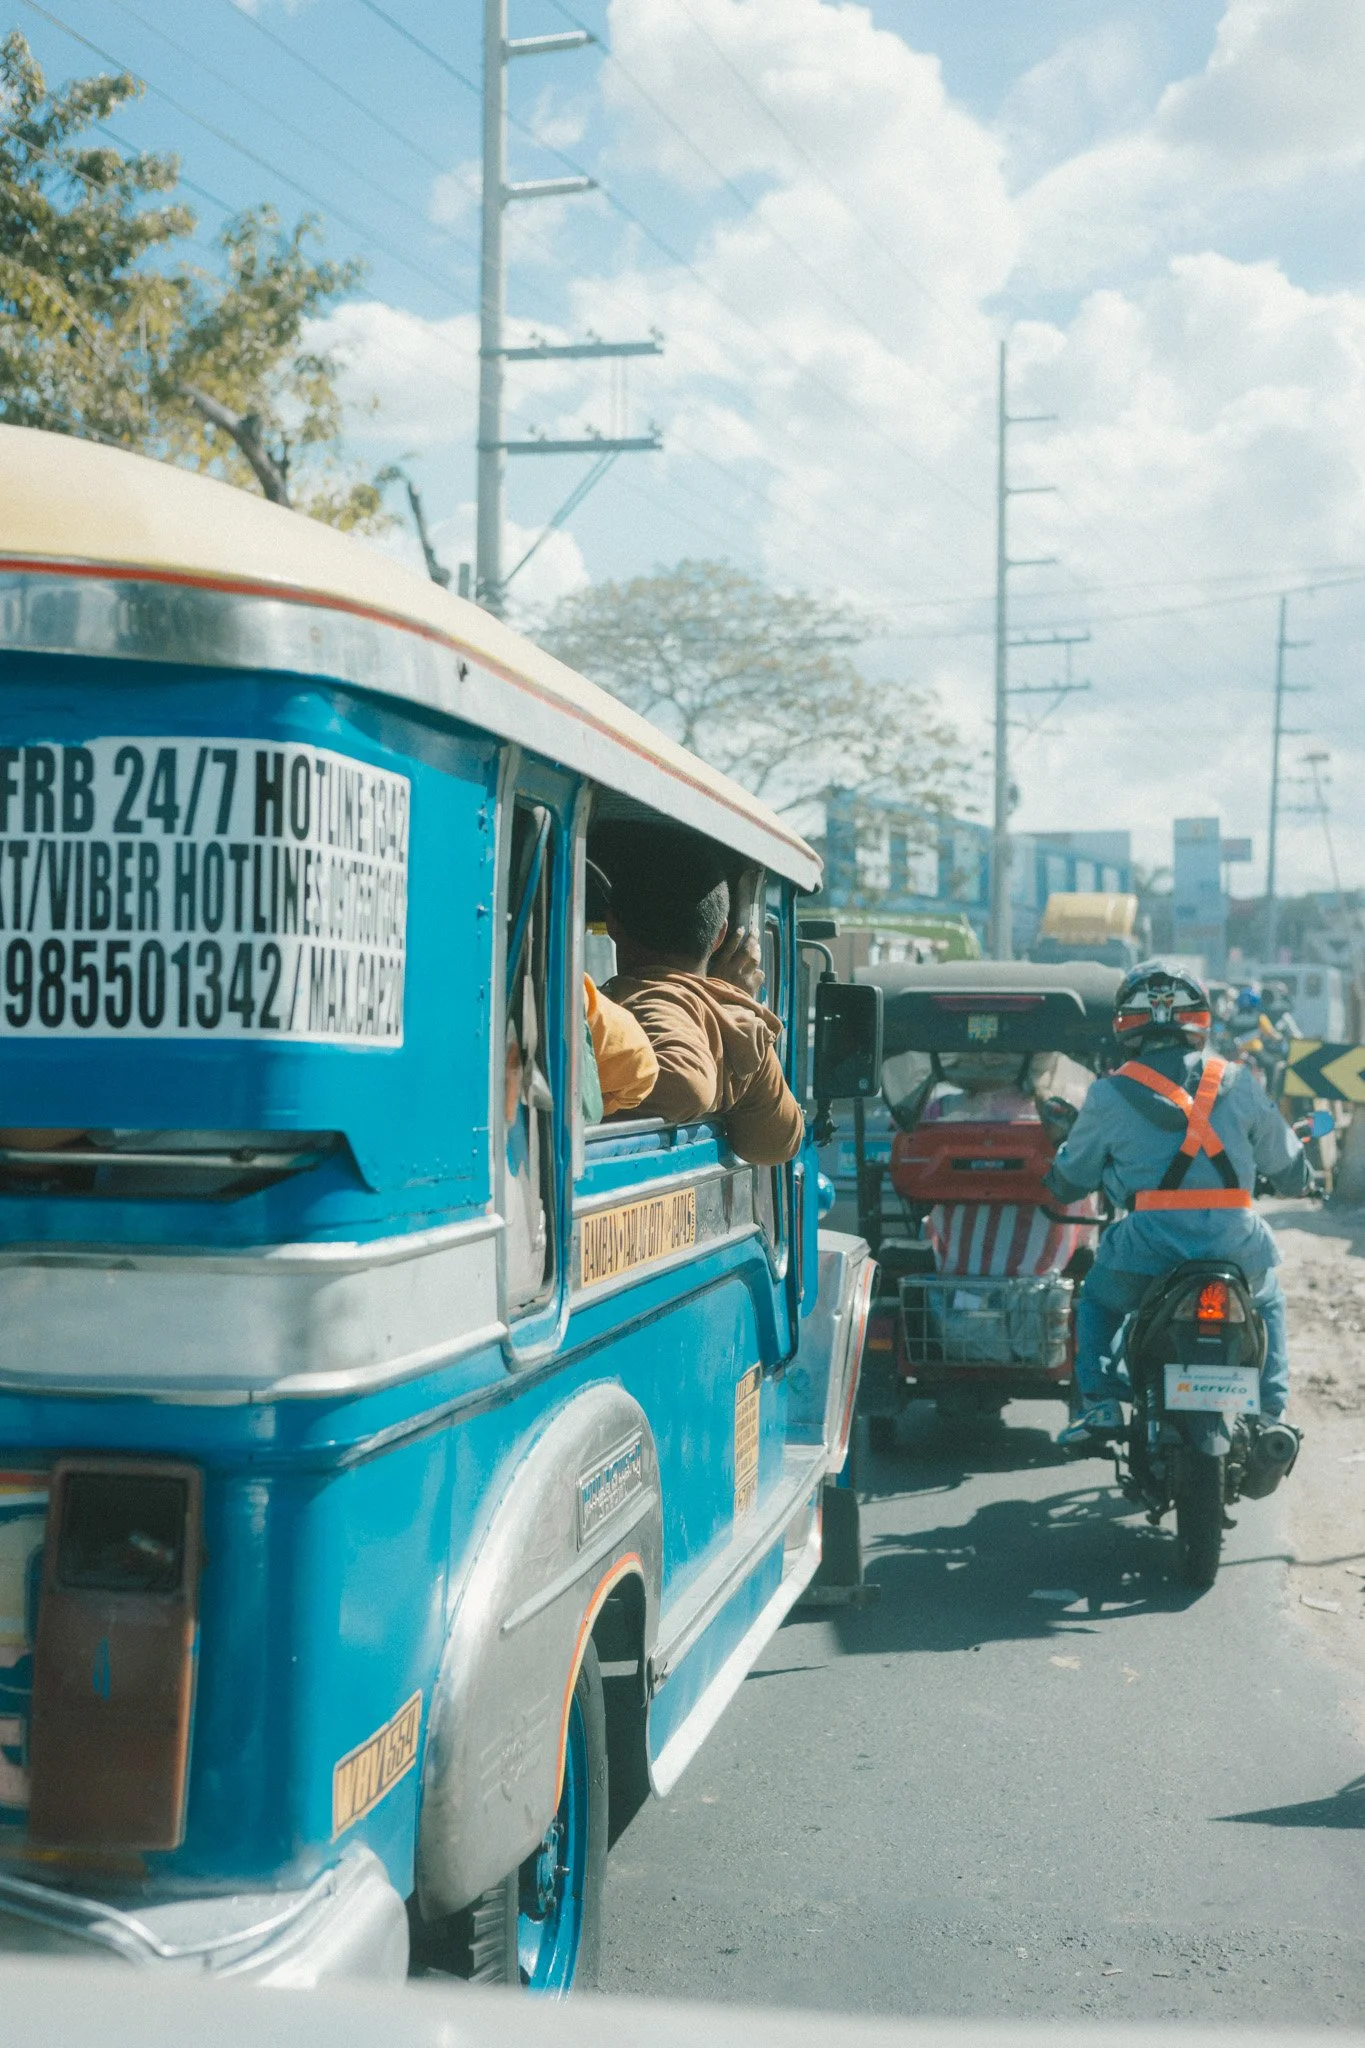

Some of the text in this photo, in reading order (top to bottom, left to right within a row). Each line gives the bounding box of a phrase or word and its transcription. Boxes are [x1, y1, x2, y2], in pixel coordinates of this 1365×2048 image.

[0, 746, 95, 834] FRB
[113, 745, 238, 836] 24/7
[254, 750, 366, 853] HOTLINE
[0, 839, 160, 932] T/VIBER
[173, 840, 322, 937] HOTLINES
